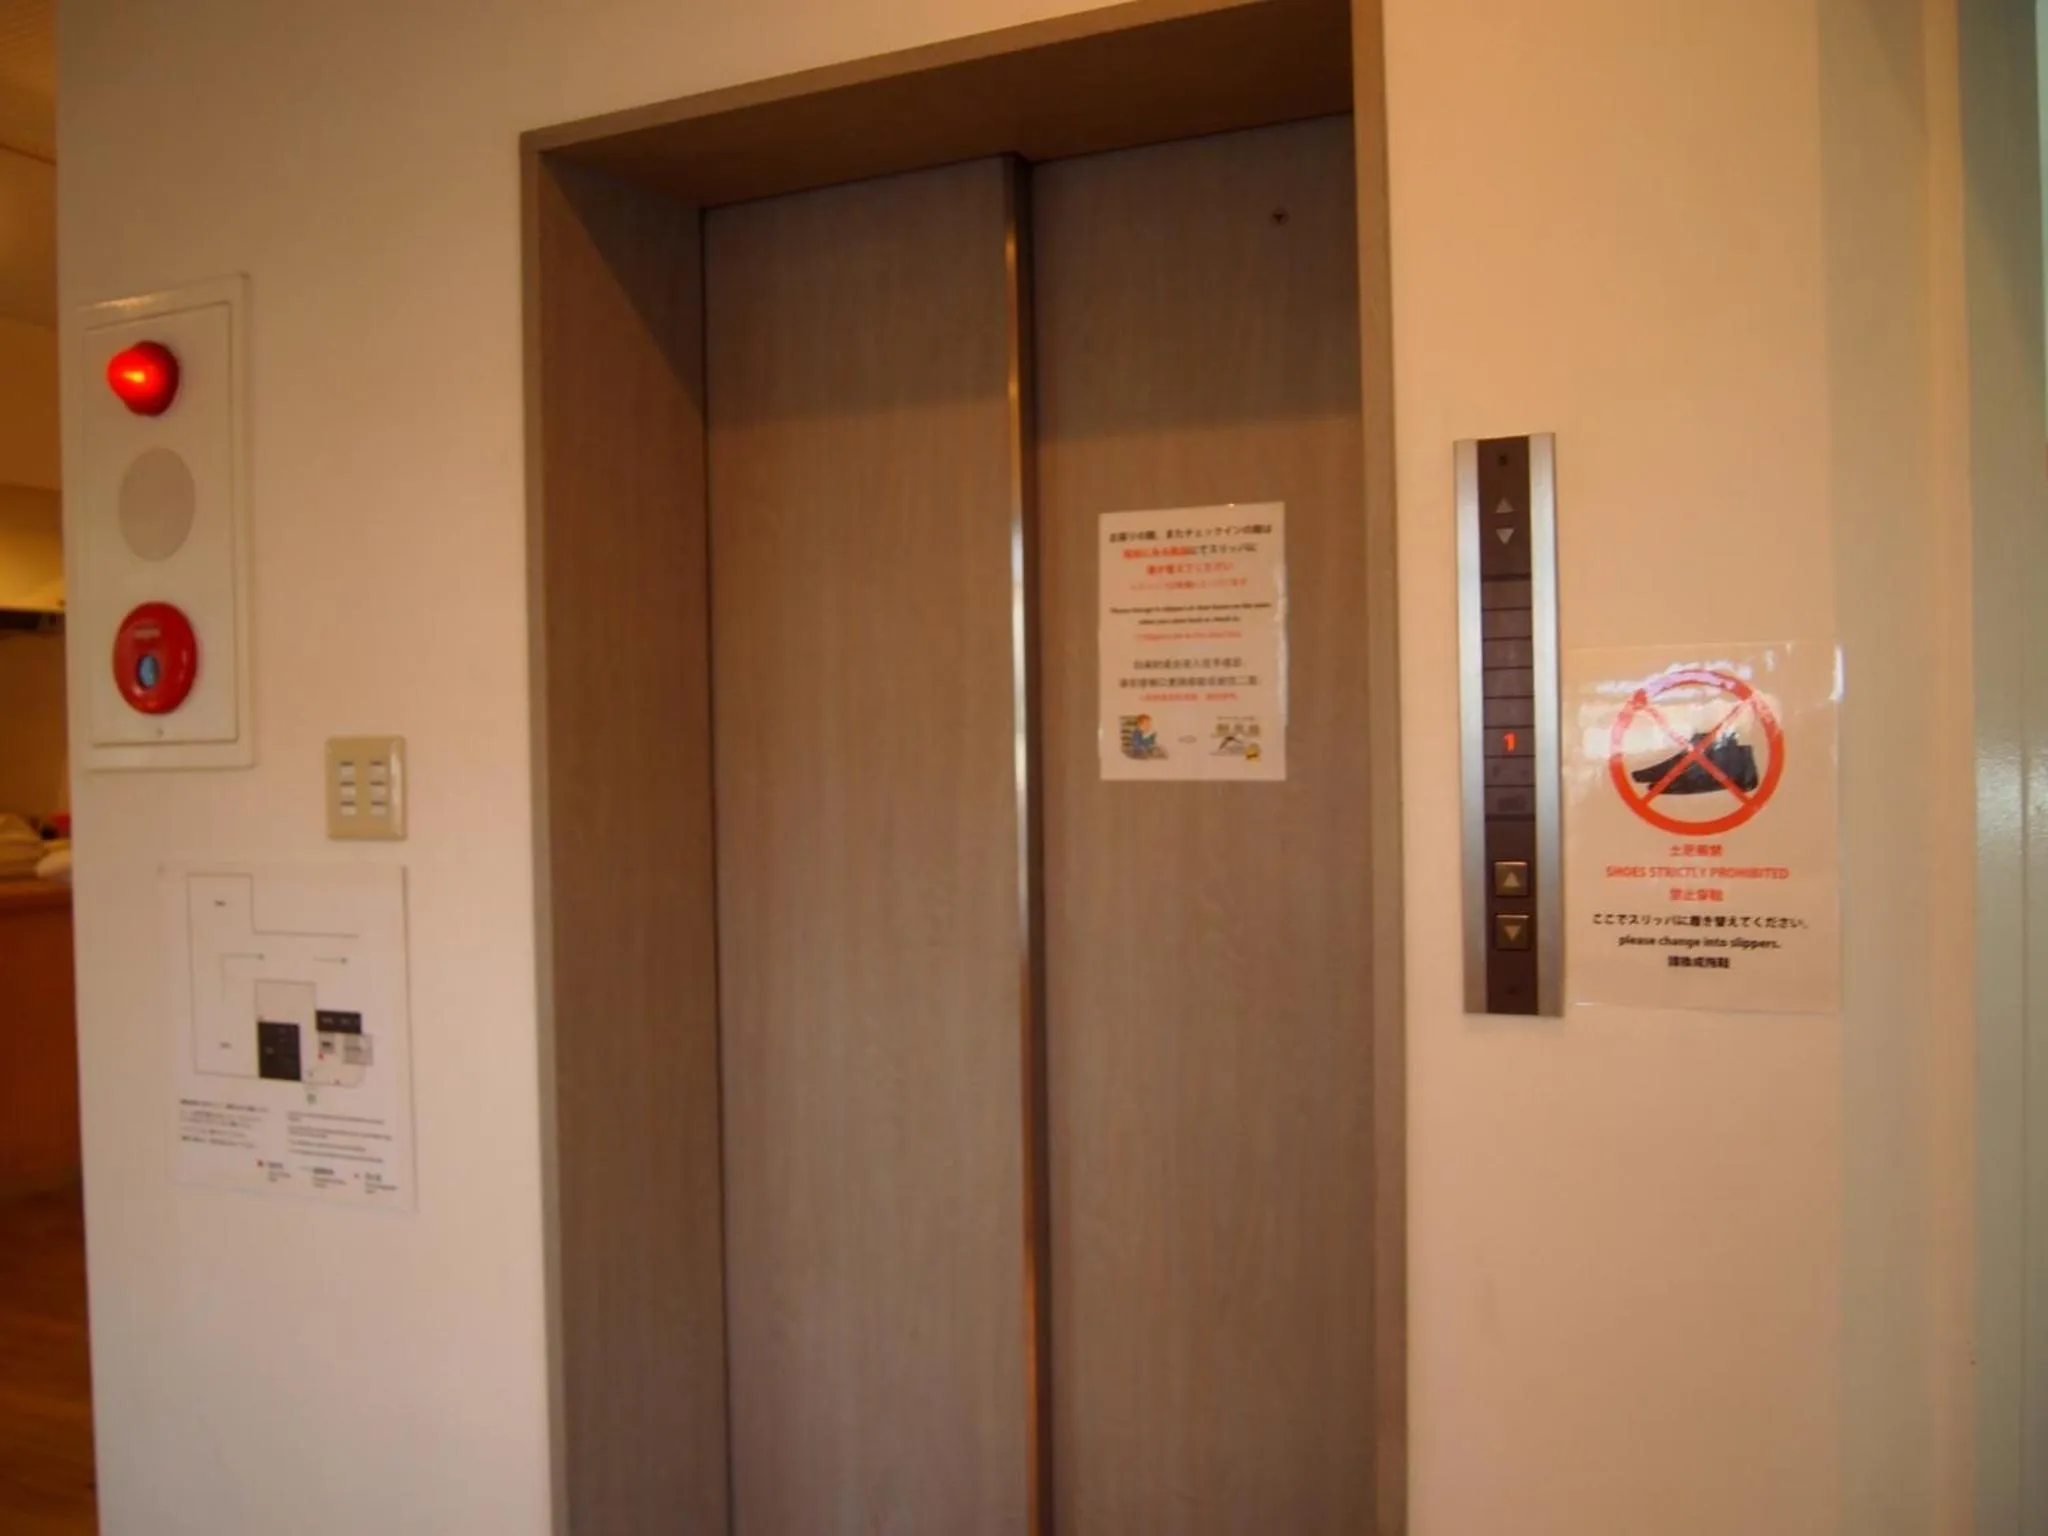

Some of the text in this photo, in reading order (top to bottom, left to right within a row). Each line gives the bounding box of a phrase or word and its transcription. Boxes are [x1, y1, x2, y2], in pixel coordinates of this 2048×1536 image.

[1504, 733, 1516, 751] 1
[1606, 866, 1790, 880] SHOES STRICTLY PROHIBITED
[1618, 934, 1782, 951] please change into slippers.
